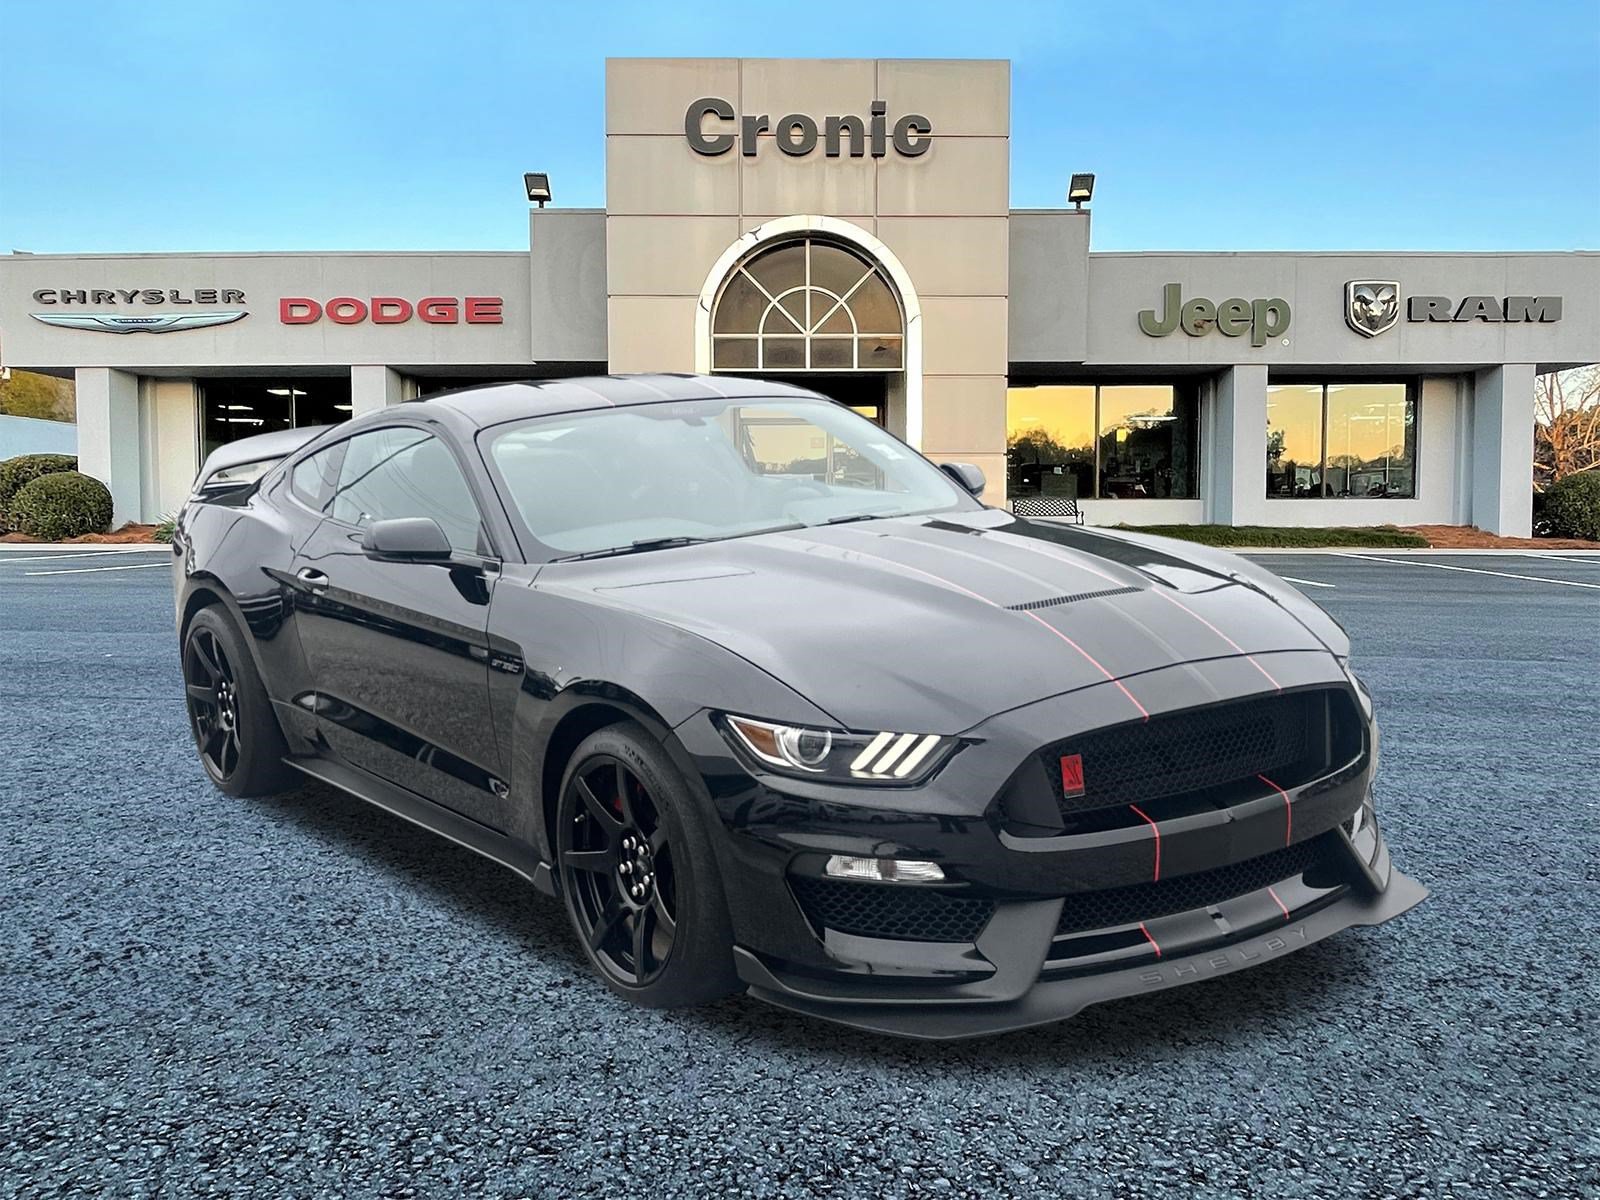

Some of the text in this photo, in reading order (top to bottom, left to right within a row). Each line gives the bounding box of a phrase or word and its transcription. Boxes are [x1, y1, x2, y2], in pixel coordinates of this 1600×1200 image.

[684, 97, 932, 158] Cronic
[32, 289, 247, 305] CHRYSLER
[279, 297, 504, 325] DODGE
[1138, 283, 1292, 347] Jeep
[1407, 296, 1563, 323] RAM
[1139, 926, 1309, 986] SHELBY
